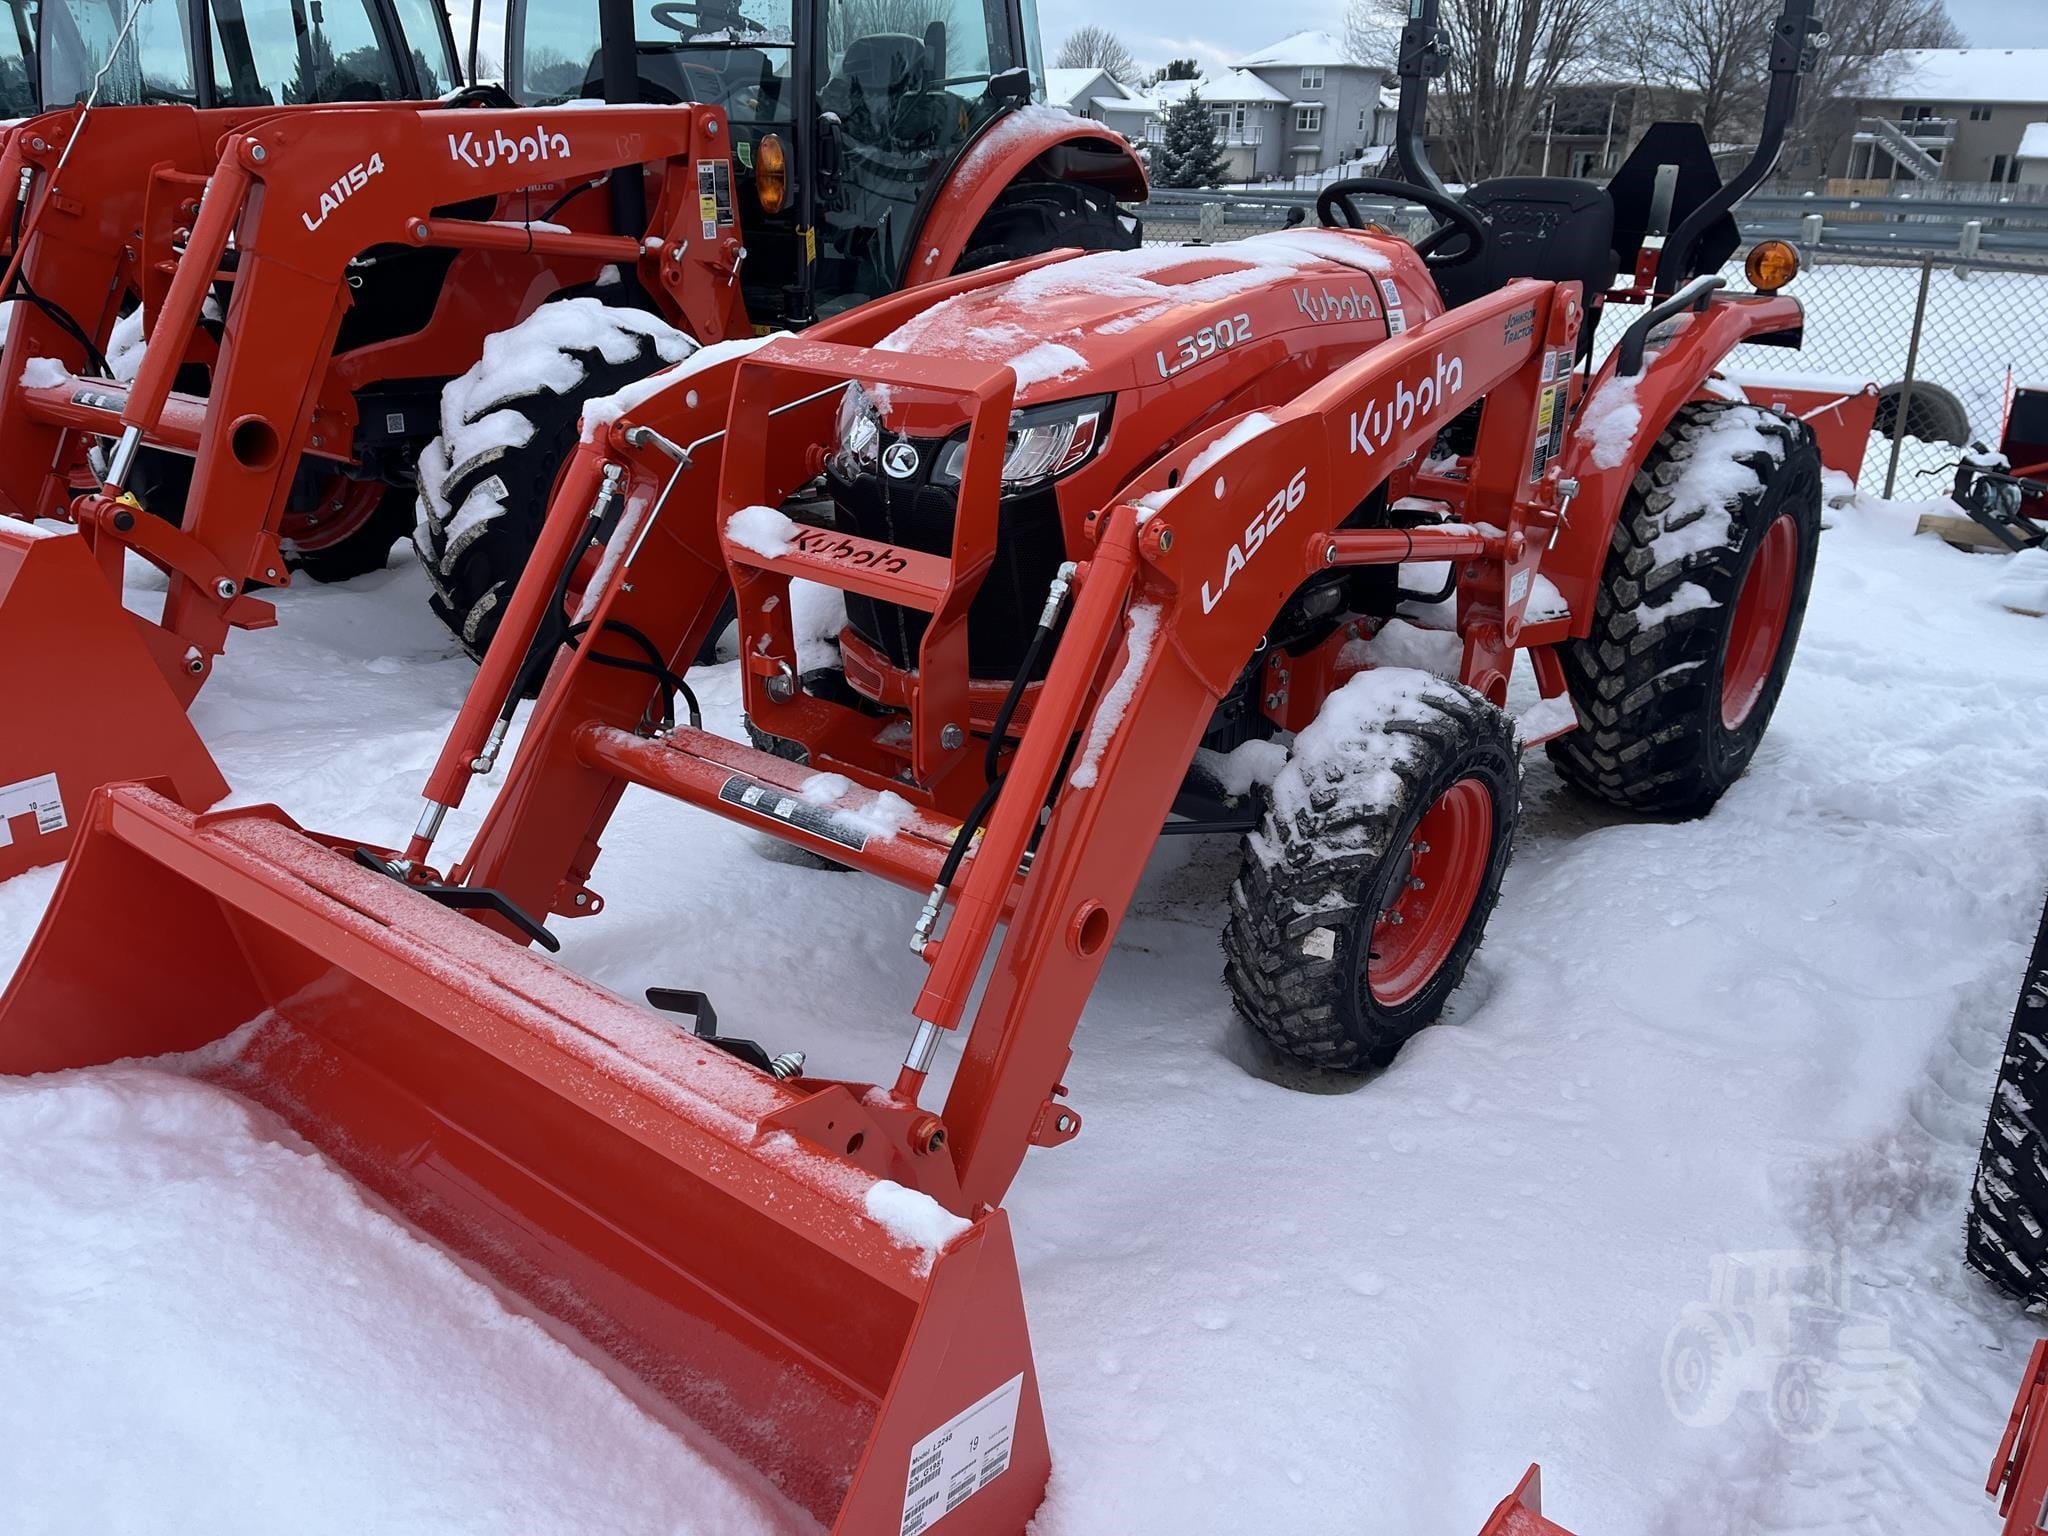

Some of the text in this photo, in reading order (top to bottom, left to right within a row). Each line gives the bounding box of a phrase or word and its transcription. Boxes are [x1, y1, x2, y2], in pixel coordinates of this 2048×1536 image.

[448, 125, 571, 168] Kubota
[301, 152, 385, 232] LA1154
[1292, 286, 1376, 323] Kubota
[1156, 313, 1252, 379] L3902
[1350, 352, 1463, 457] Kubota
[789, 529, 908, 574] Kubota
[1201, 466, 1307, 615] LA526
[969, 1435, 979, 1453] 19
